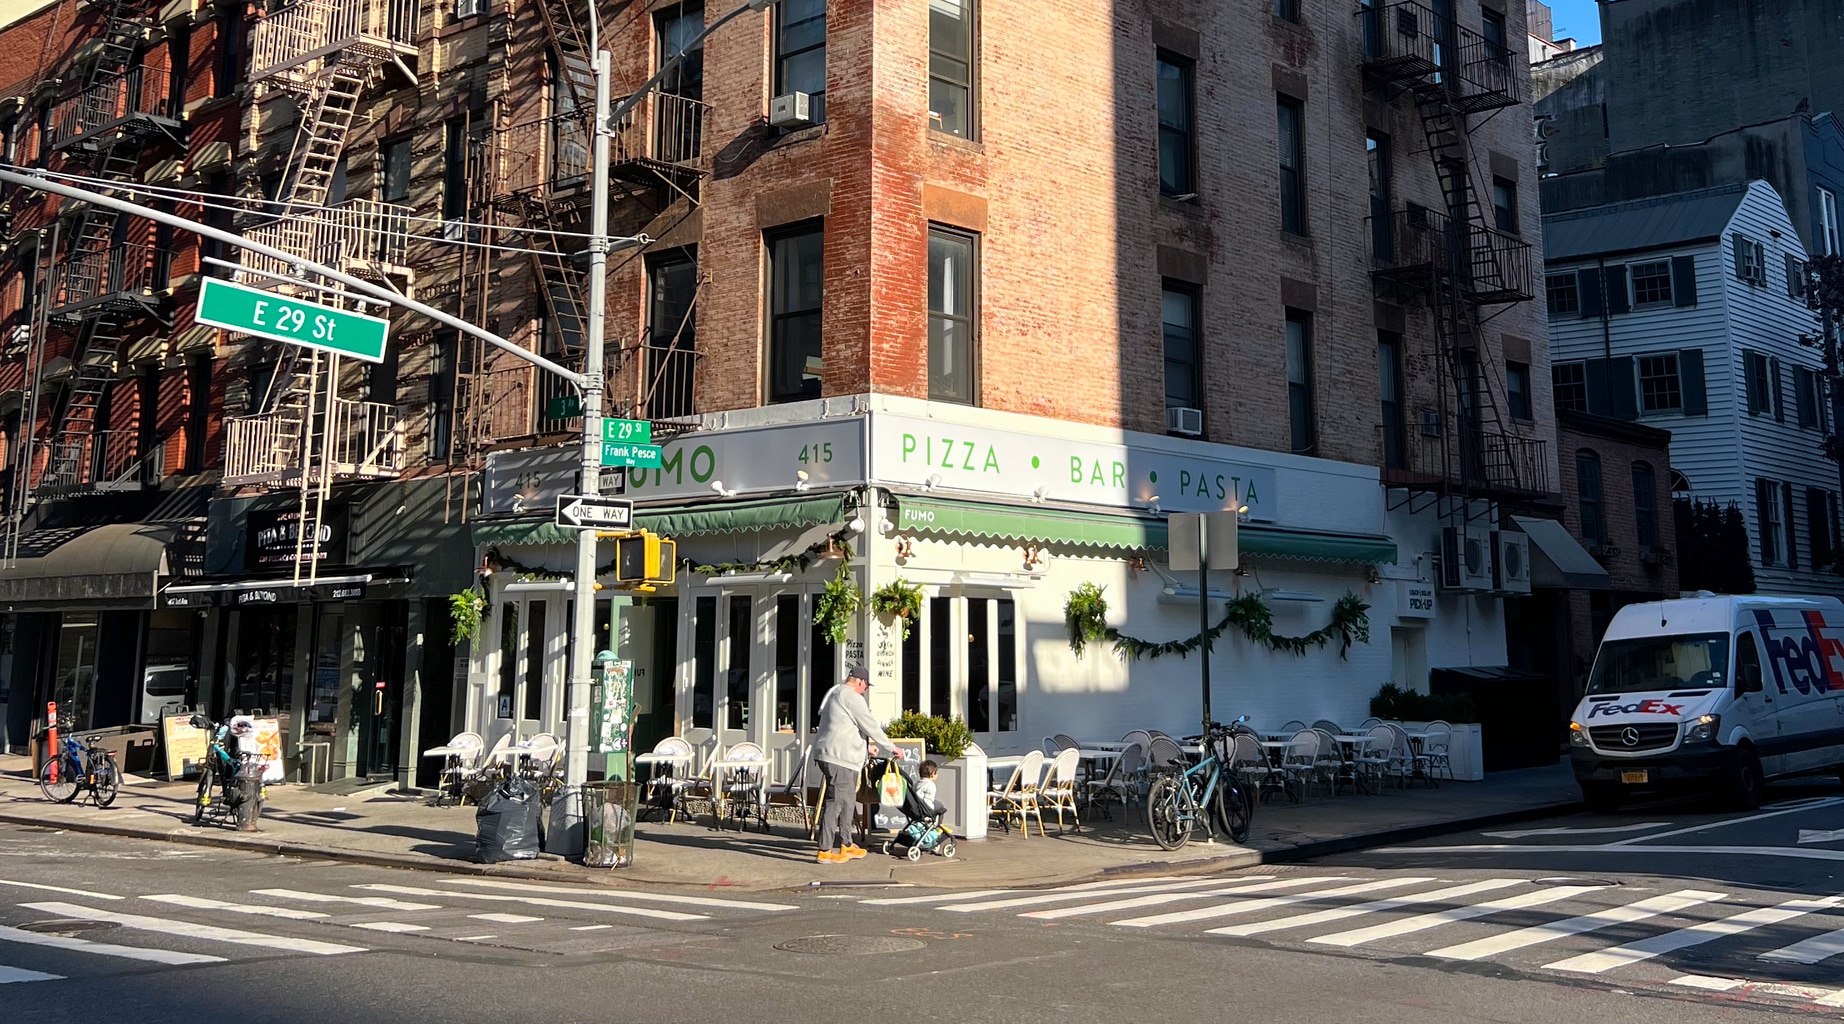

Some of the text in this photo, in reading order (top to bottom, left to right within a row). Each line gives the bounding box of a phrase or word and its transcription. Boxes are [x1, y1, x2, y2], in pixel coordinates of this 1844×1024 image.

[253, 300, 337, 341] E 29 St
[560, 399, 566, 416] 3
[608, 422, 643, 439] E 29 St
[604, 444, 657, 459] Frank Pesce
[625, 457, 636, 466] Way
[629, 442, 833, 489] UMO 415
[902, 433, 1260, 504] PIZZA BAR PASTA
[514, 470, 541, 490] 415
[602, 476, 620, 488] WAY
[572, 506, 625, 520] ONE WAY
[904, 508, 935, 522] FUMO
[257, 523, 332, 547] PITA & BEOND
[1409, 598, 1433, 610] PICK-UP
[846, 638, 863, 648] Pizza
[845, 650, 864, 659] PASTA
[877, 670, 893, 678] WINE
[501, 698, 508, 712] A
[1587, 699, 1685, 719] FedEx
